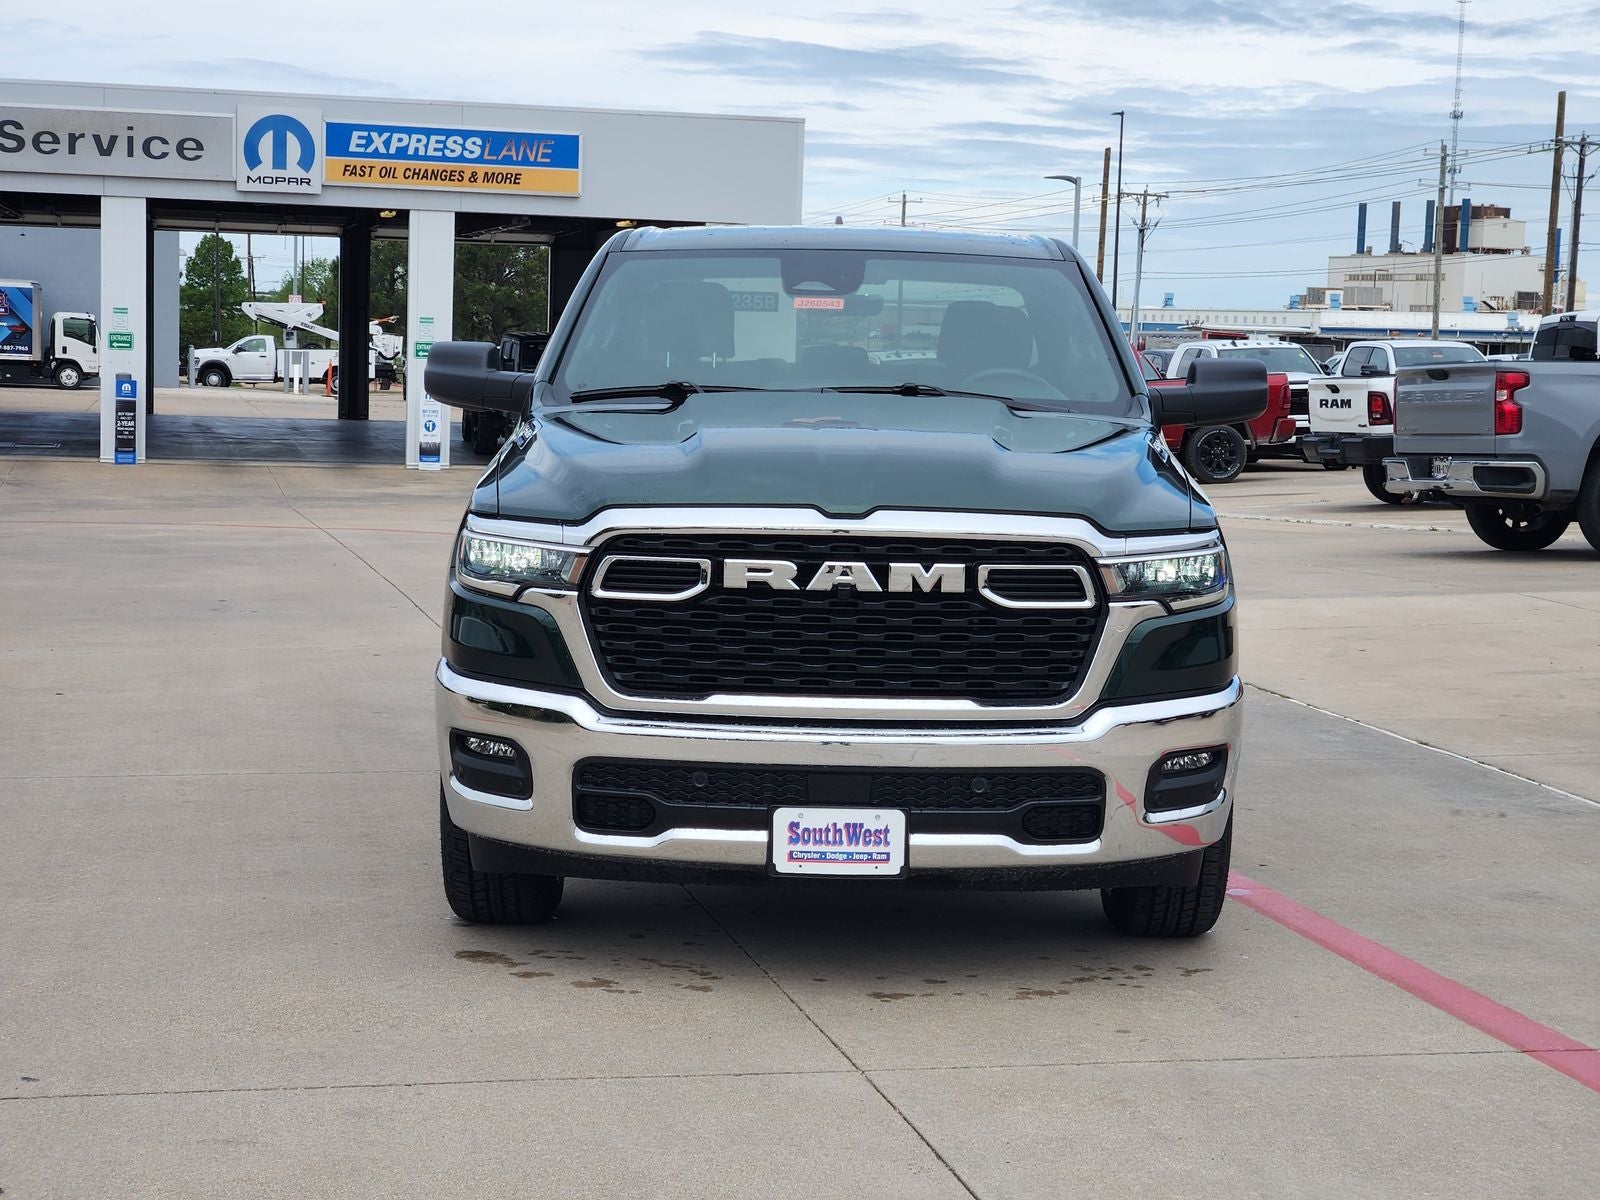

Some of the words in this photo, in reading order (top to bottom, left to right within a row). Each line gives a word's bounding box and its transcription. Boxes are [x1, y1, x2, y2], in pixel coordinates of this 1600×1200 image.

[0, 119, 205, 161] Service
[246, 175, 312, 187] MOPAR
[342, 165, 375, 178] FAST
[379, 166, 398, 179] OIL
[403, 168, 464, 183] CHANGES
[468, 171, 478, 183] &
[482, 171, 522, 185] MORE
[110, 334, 131, 342] ENTRANCE
[1319, 398, 1352, 409] RAM
[724, 558, 966, 593] RAM
[787, 821, 891, 847] SouthWest
[792, 851, 820, 861] Chrysler
[826, 852, 847, 861] Dodge
[852, 853, 868, 862] Jeep
